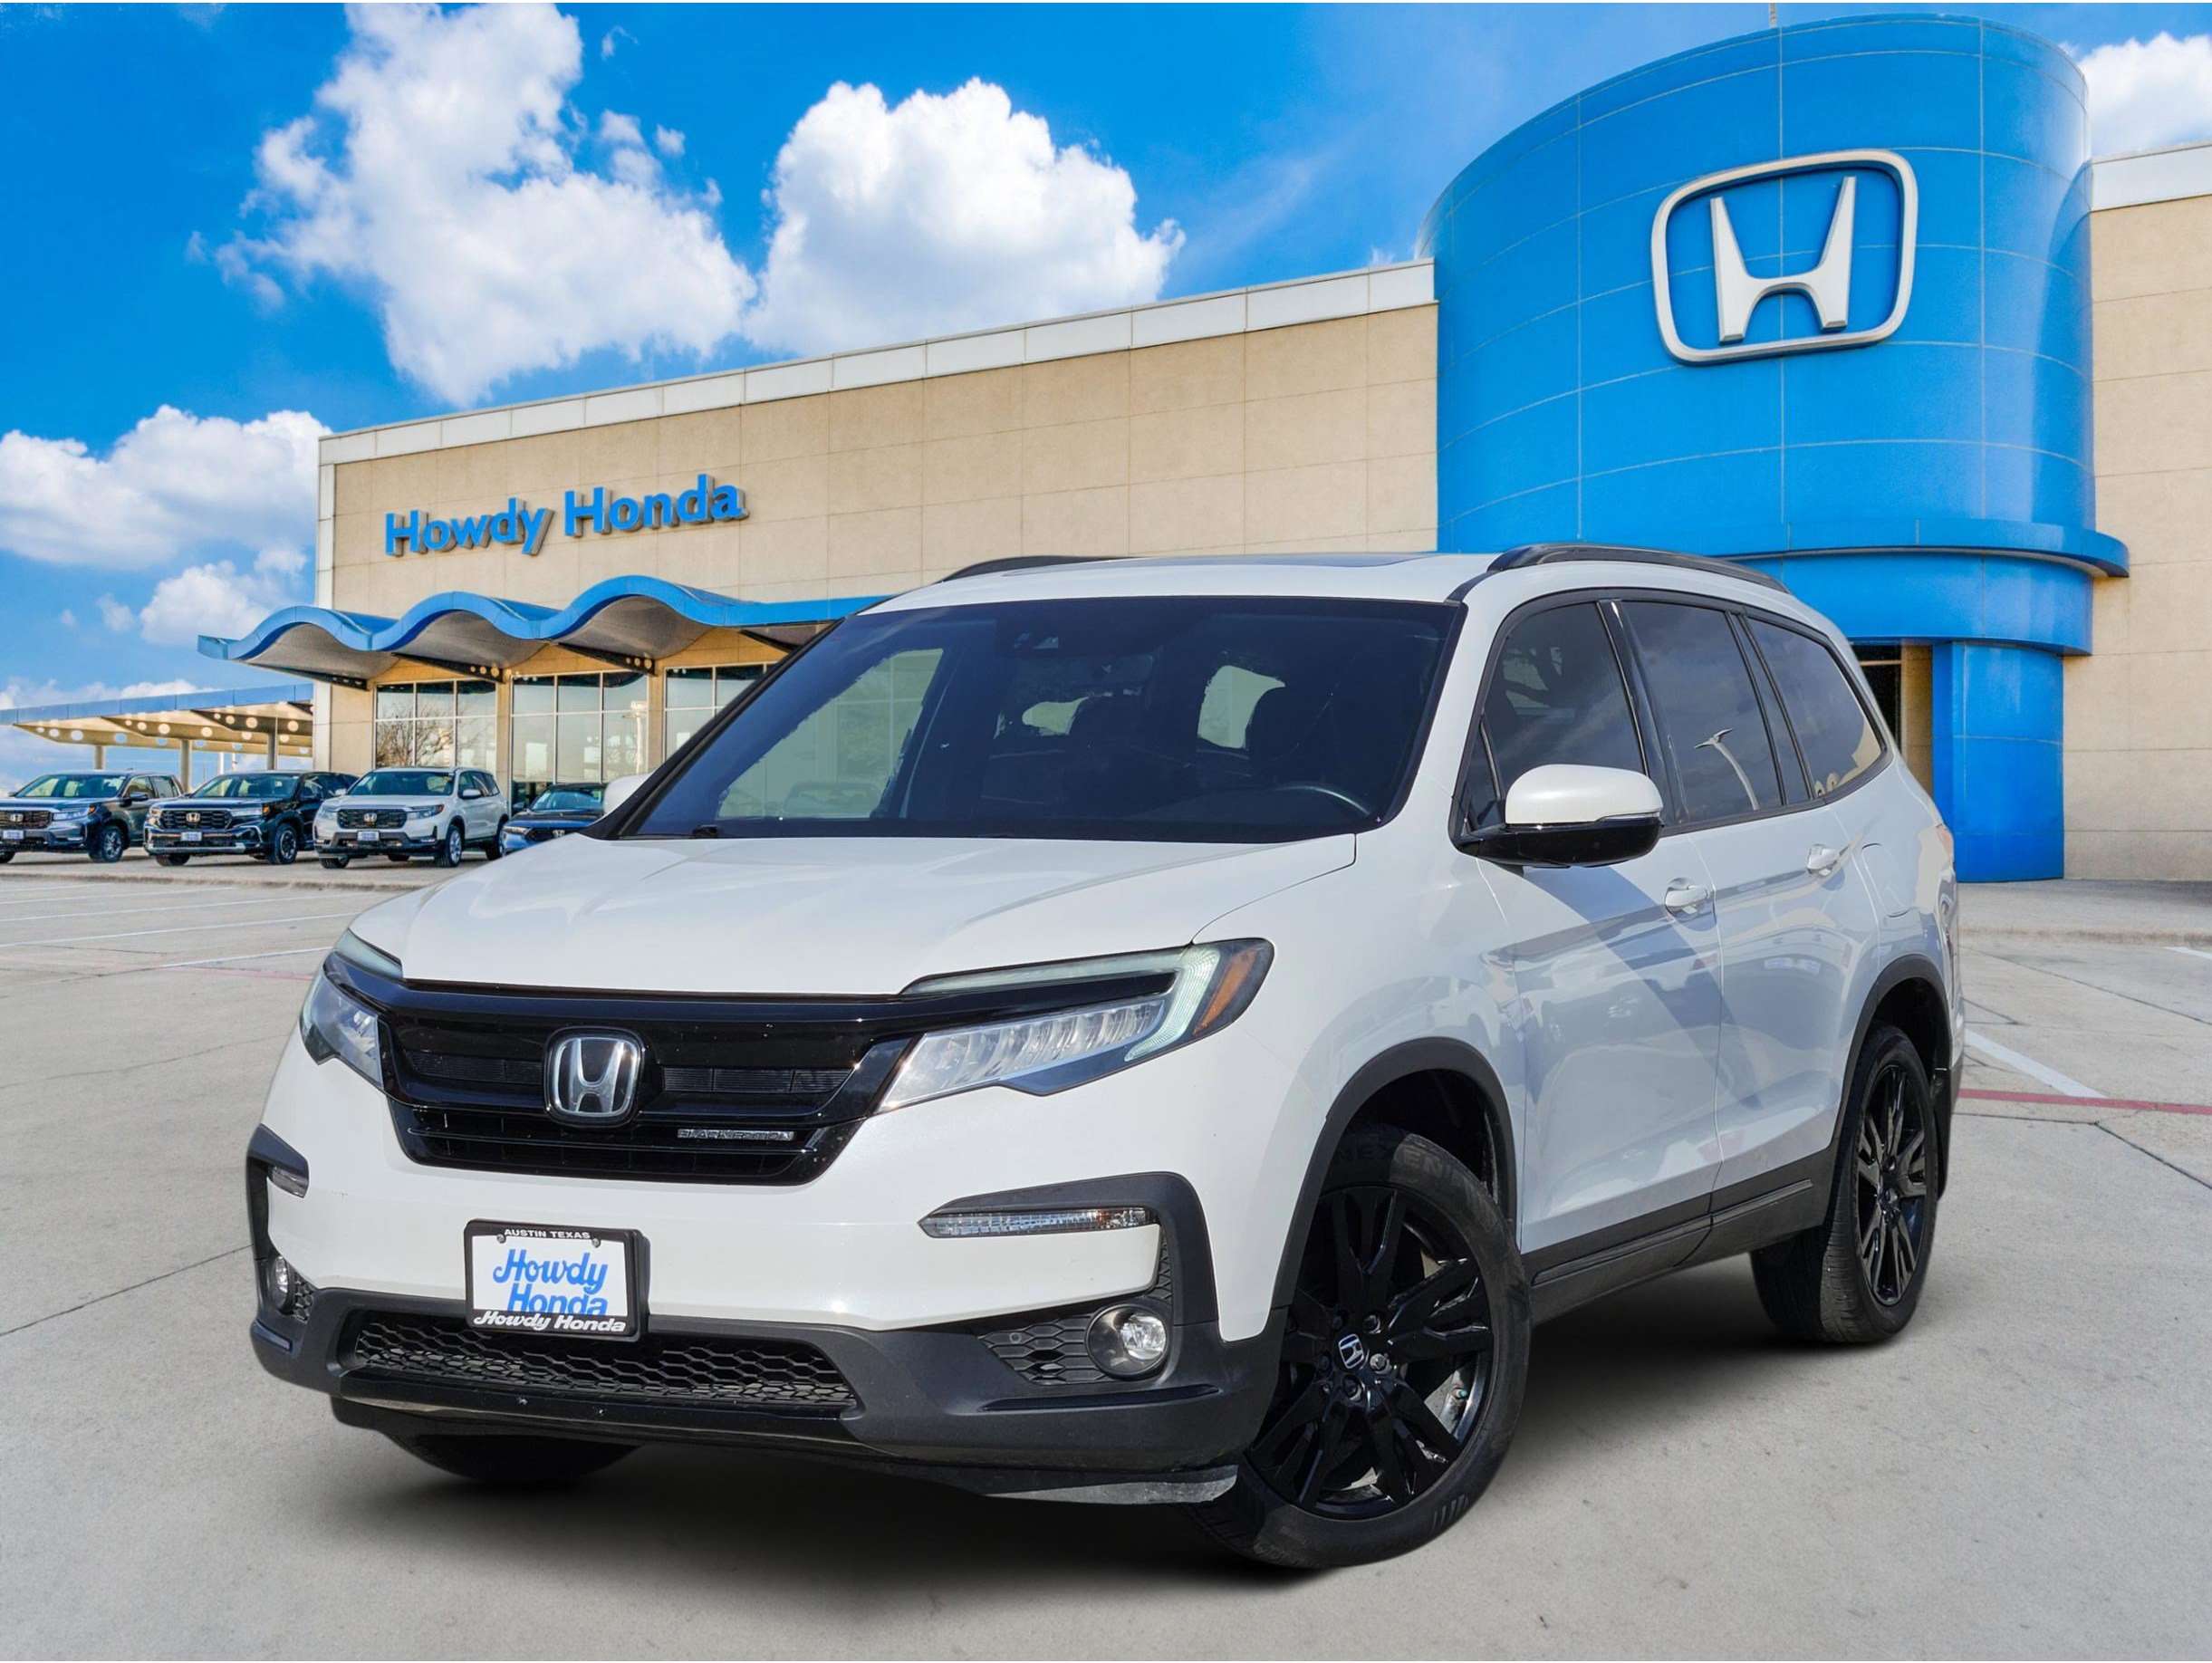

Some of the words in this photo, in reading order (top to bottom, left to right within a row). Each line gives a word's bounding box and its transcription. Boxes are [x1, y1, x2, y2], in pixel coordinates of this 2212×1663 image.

[385, 496, 554, 556] Howdy
[564, 474, 749, 538] Honda
[505, 1228, 547, 1238] AUSTIN
[550, 1230, 591, 1239] TEXAS
[493, 1249, 609, 1295] Howdy
[507, 1283, 609, 1317] Honda
[473, 1311, 552, 1331] Howdy
[553, 1315, 627, 1332] Honda
